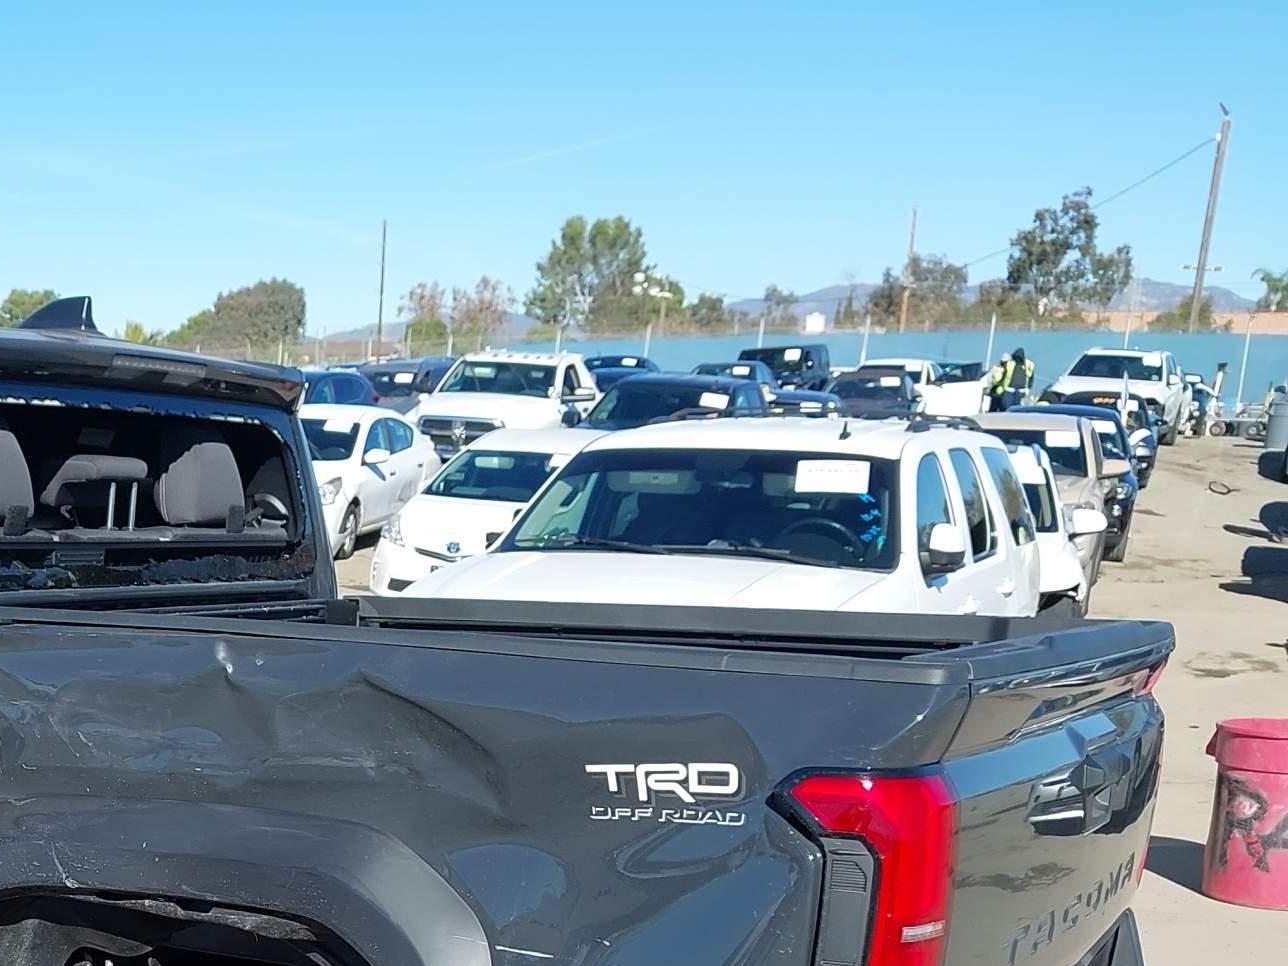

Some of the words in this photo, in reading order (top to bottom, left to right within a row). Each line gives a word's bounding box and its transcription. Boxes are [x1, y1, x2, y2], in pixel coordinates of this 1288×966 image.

[584, 762, 740, 804] TRD
[589, 806, 653, 822] OFF
[657, 808, 746, 826] ROAD
